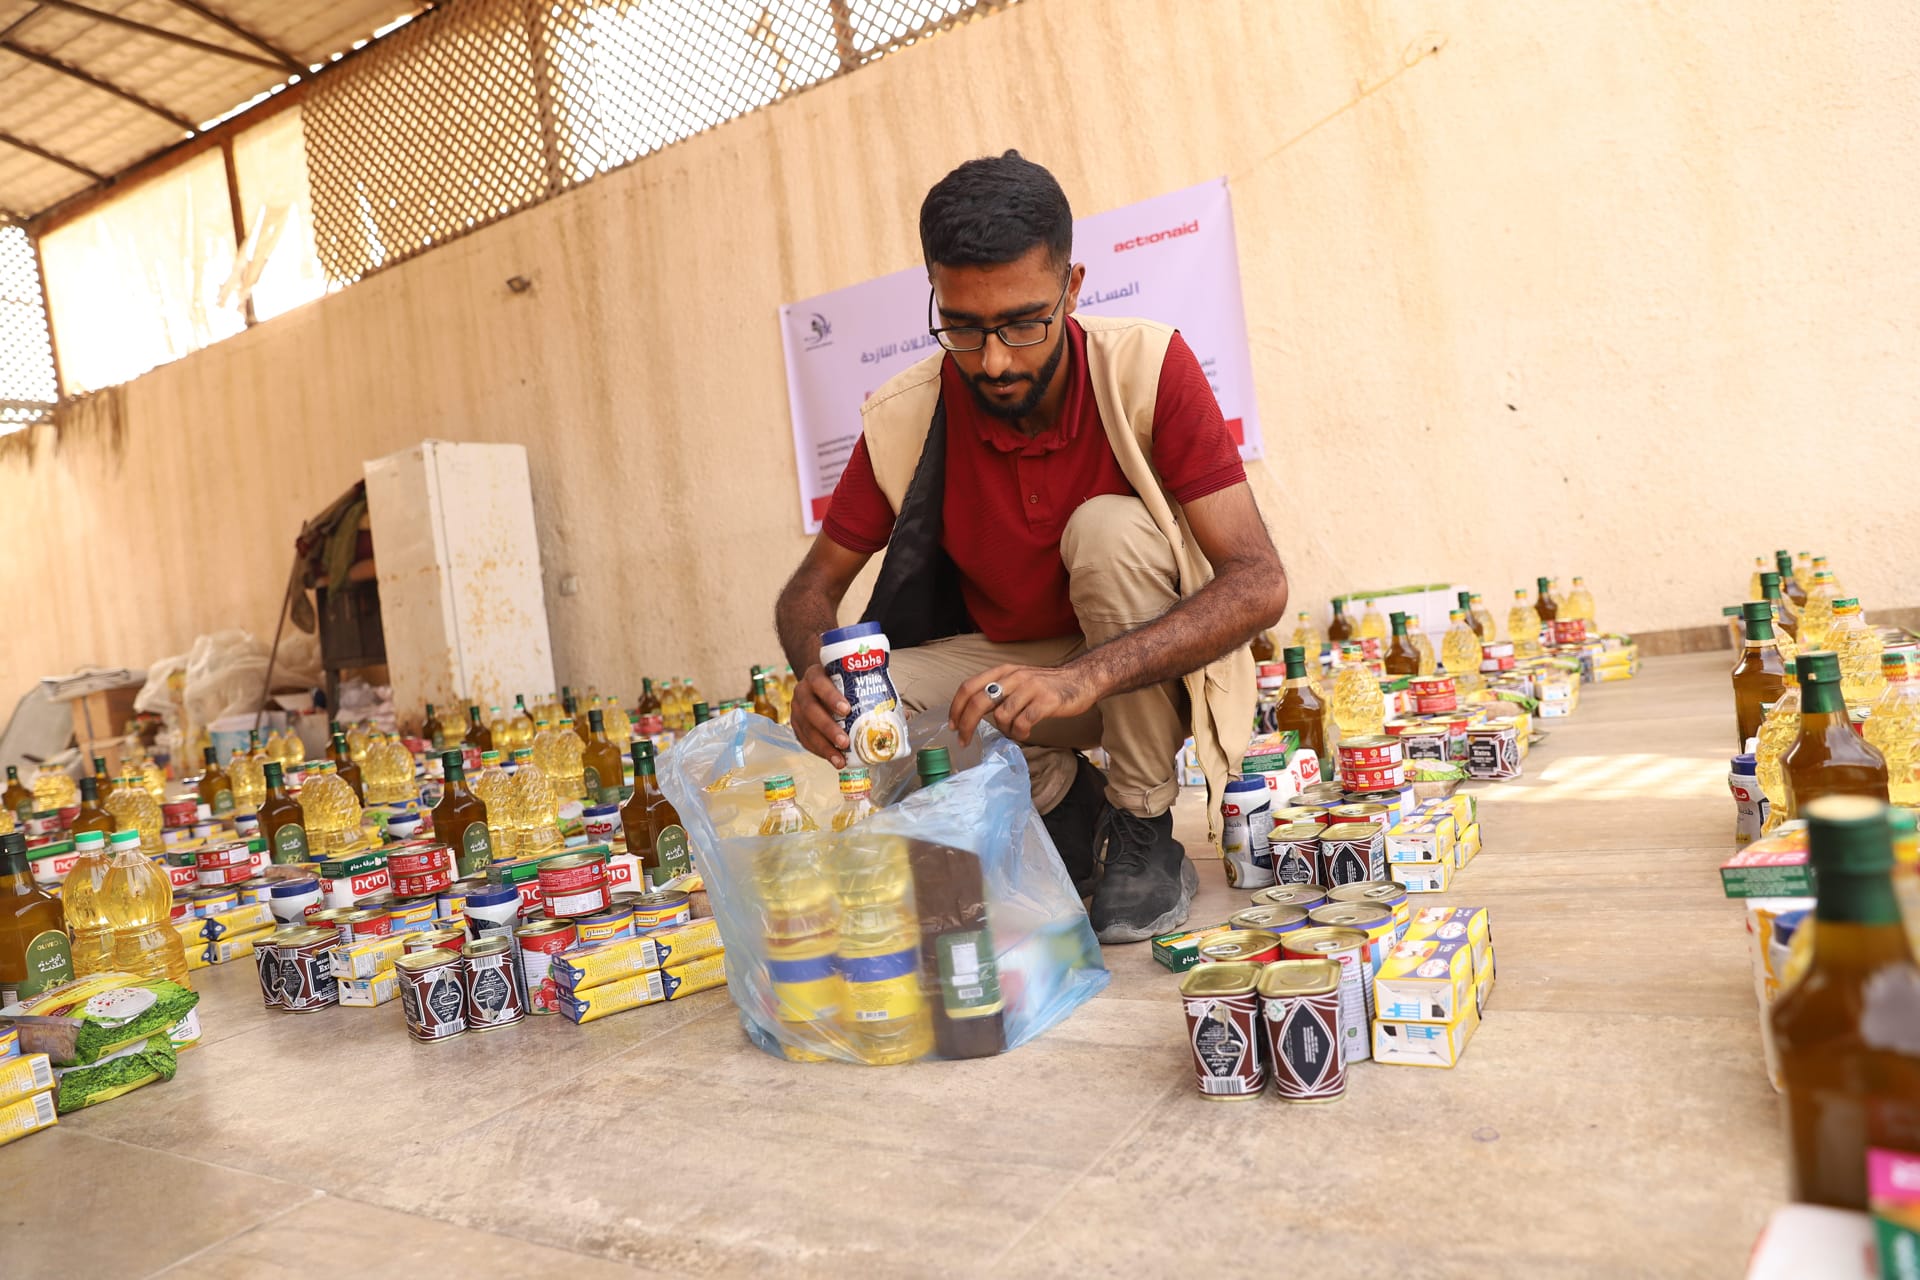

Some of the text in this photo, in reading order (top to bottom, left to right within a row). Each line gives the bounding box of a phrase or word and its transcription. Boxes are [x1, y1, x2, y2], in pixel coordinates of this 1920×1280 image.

[847, 654, 882, 671] Sabha
[855, 673, 882, 687] White
[855, 684, 888, 698] Tahina
[355, 874, 386, 891] סוגת
